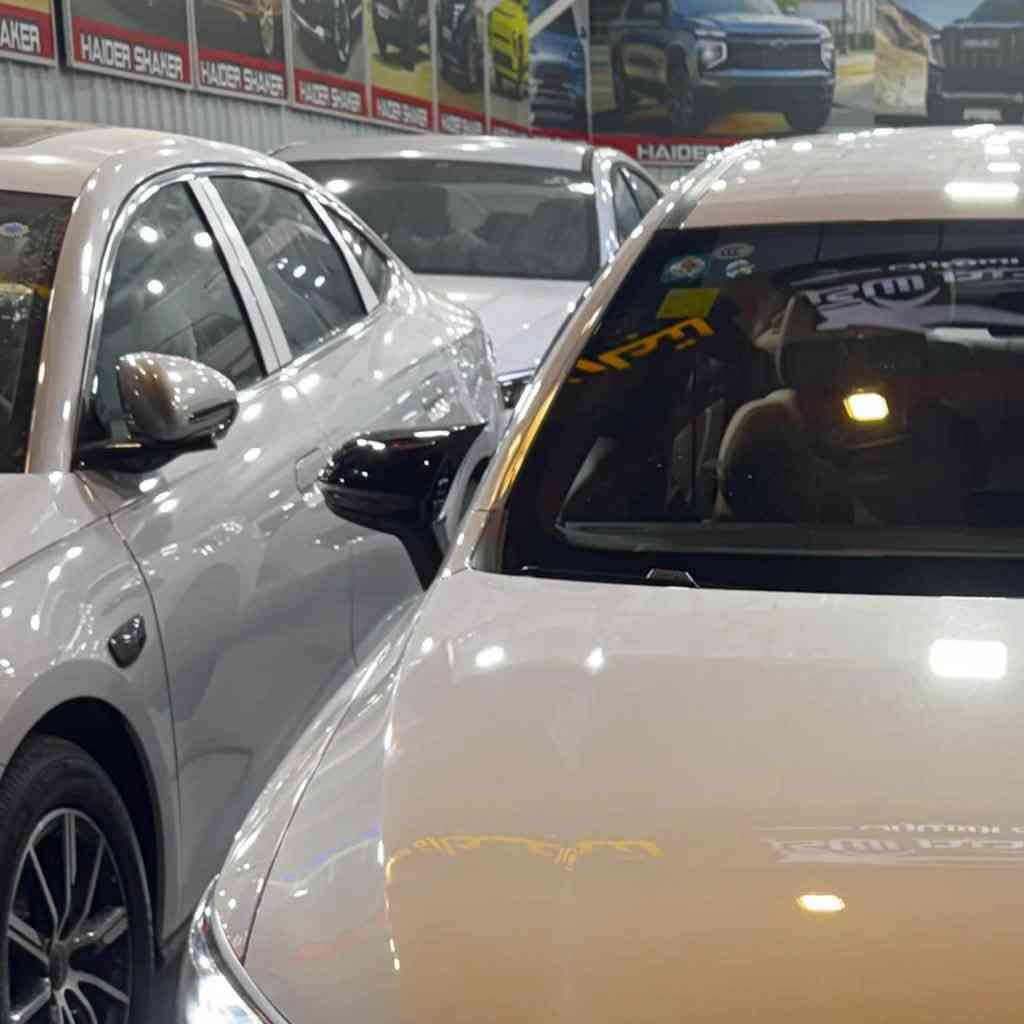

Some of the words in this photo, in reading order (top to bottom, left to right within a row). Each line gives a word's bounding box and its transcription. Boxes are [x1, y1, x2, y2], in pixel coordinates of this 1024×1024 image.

[79, 33, 132, 71] HAIDER
[133, 46, 184, 81] SHAKER
[200, 61, 242, 90] HAIDER
[243, 67, 285, 99] SHAKER
